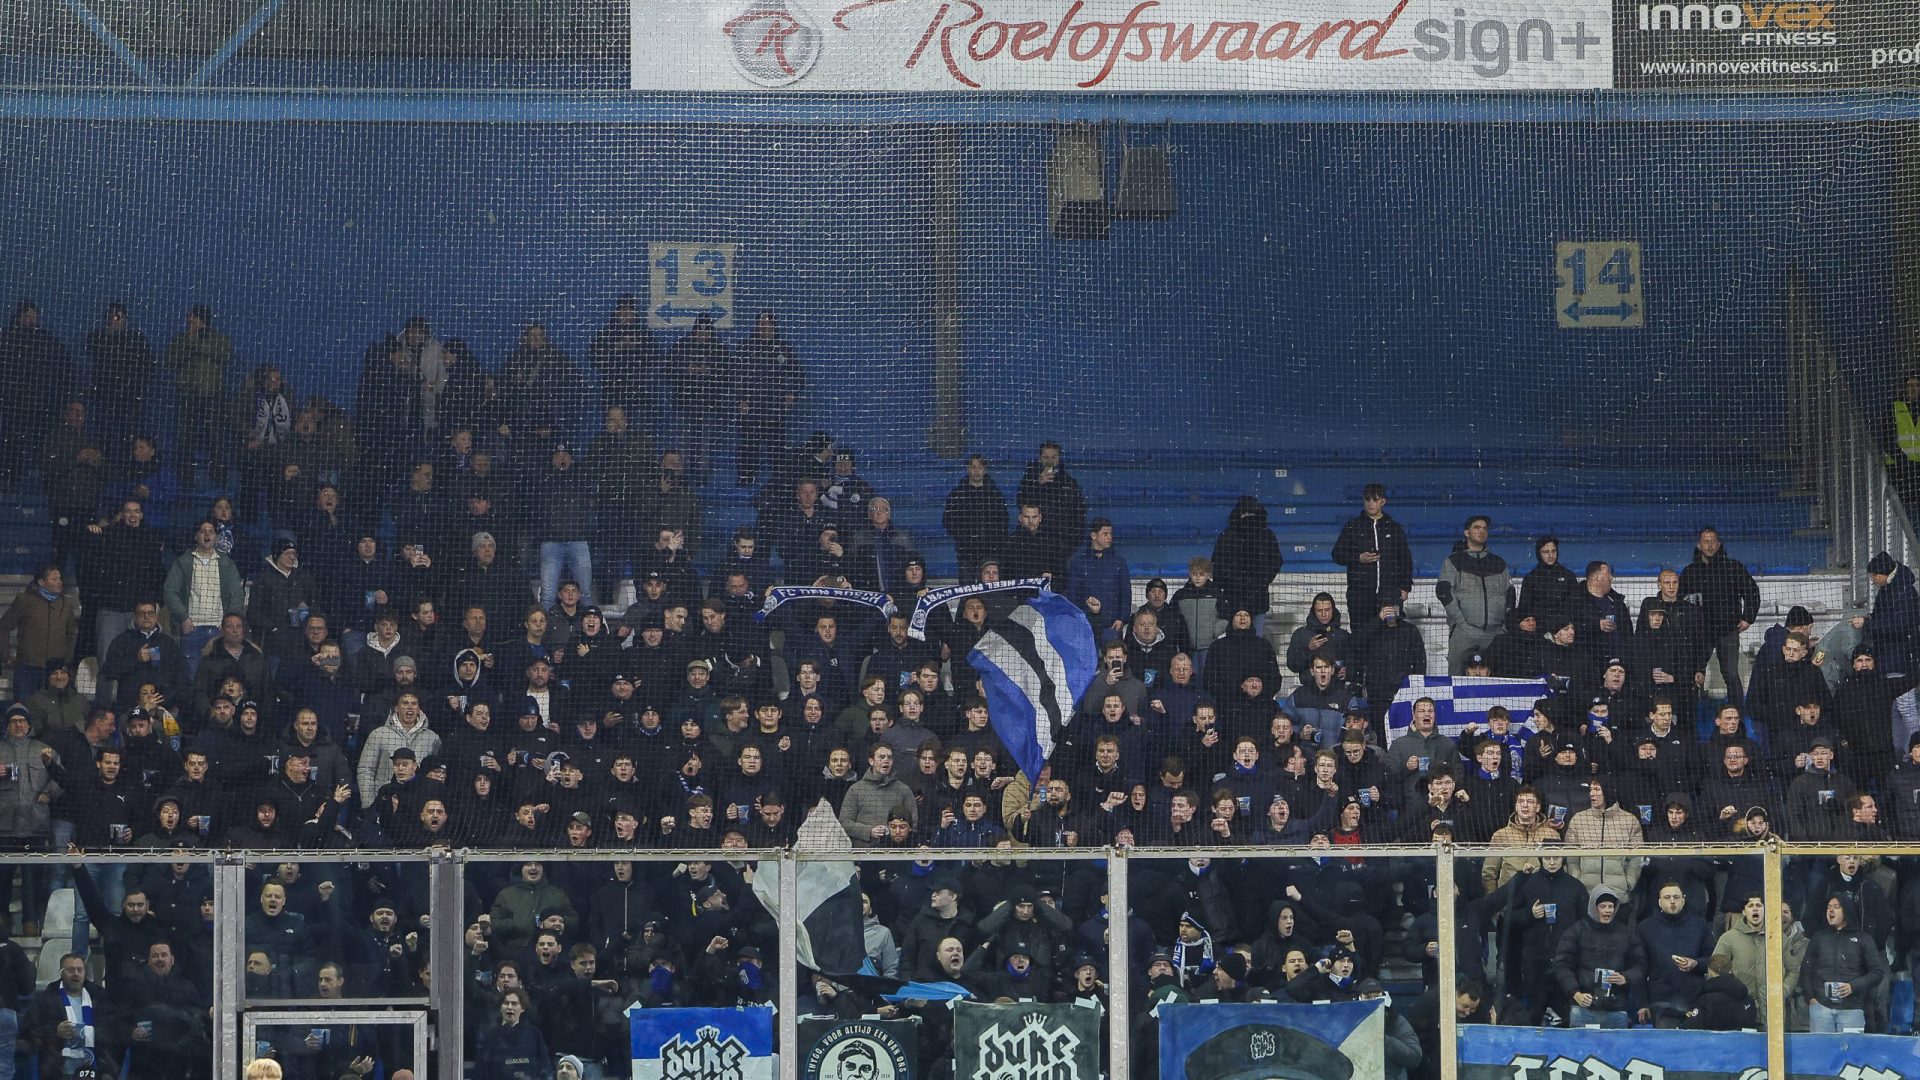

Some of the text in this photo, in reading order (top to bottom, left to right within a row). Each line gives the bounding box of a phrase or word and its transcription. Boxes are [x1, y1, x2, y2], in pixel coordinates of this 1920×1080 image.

[833, 0, 1600, 88] Roelofswaard sign+
[1741, 32, 1837, 46] FITNESS
[1640, 58, 1839, 74] www.innovexfitness.nl
[655, 249, 727, 297] 13
[1563, 248, 1636, 295] 14
[985, 579, 1016, 588] HEEL
[777, 588, 797, 598] FC
[822, 1028, 843, 1047] VOOR
[844, 1025, 872, 1035] ALTIJD
[873, 1029, 889, 1042] EEN
[887, 1039, 901, 1056] VAN
[895, 1055, 908, 1073] ONS
[79, 1070, 96, 1078] 073
